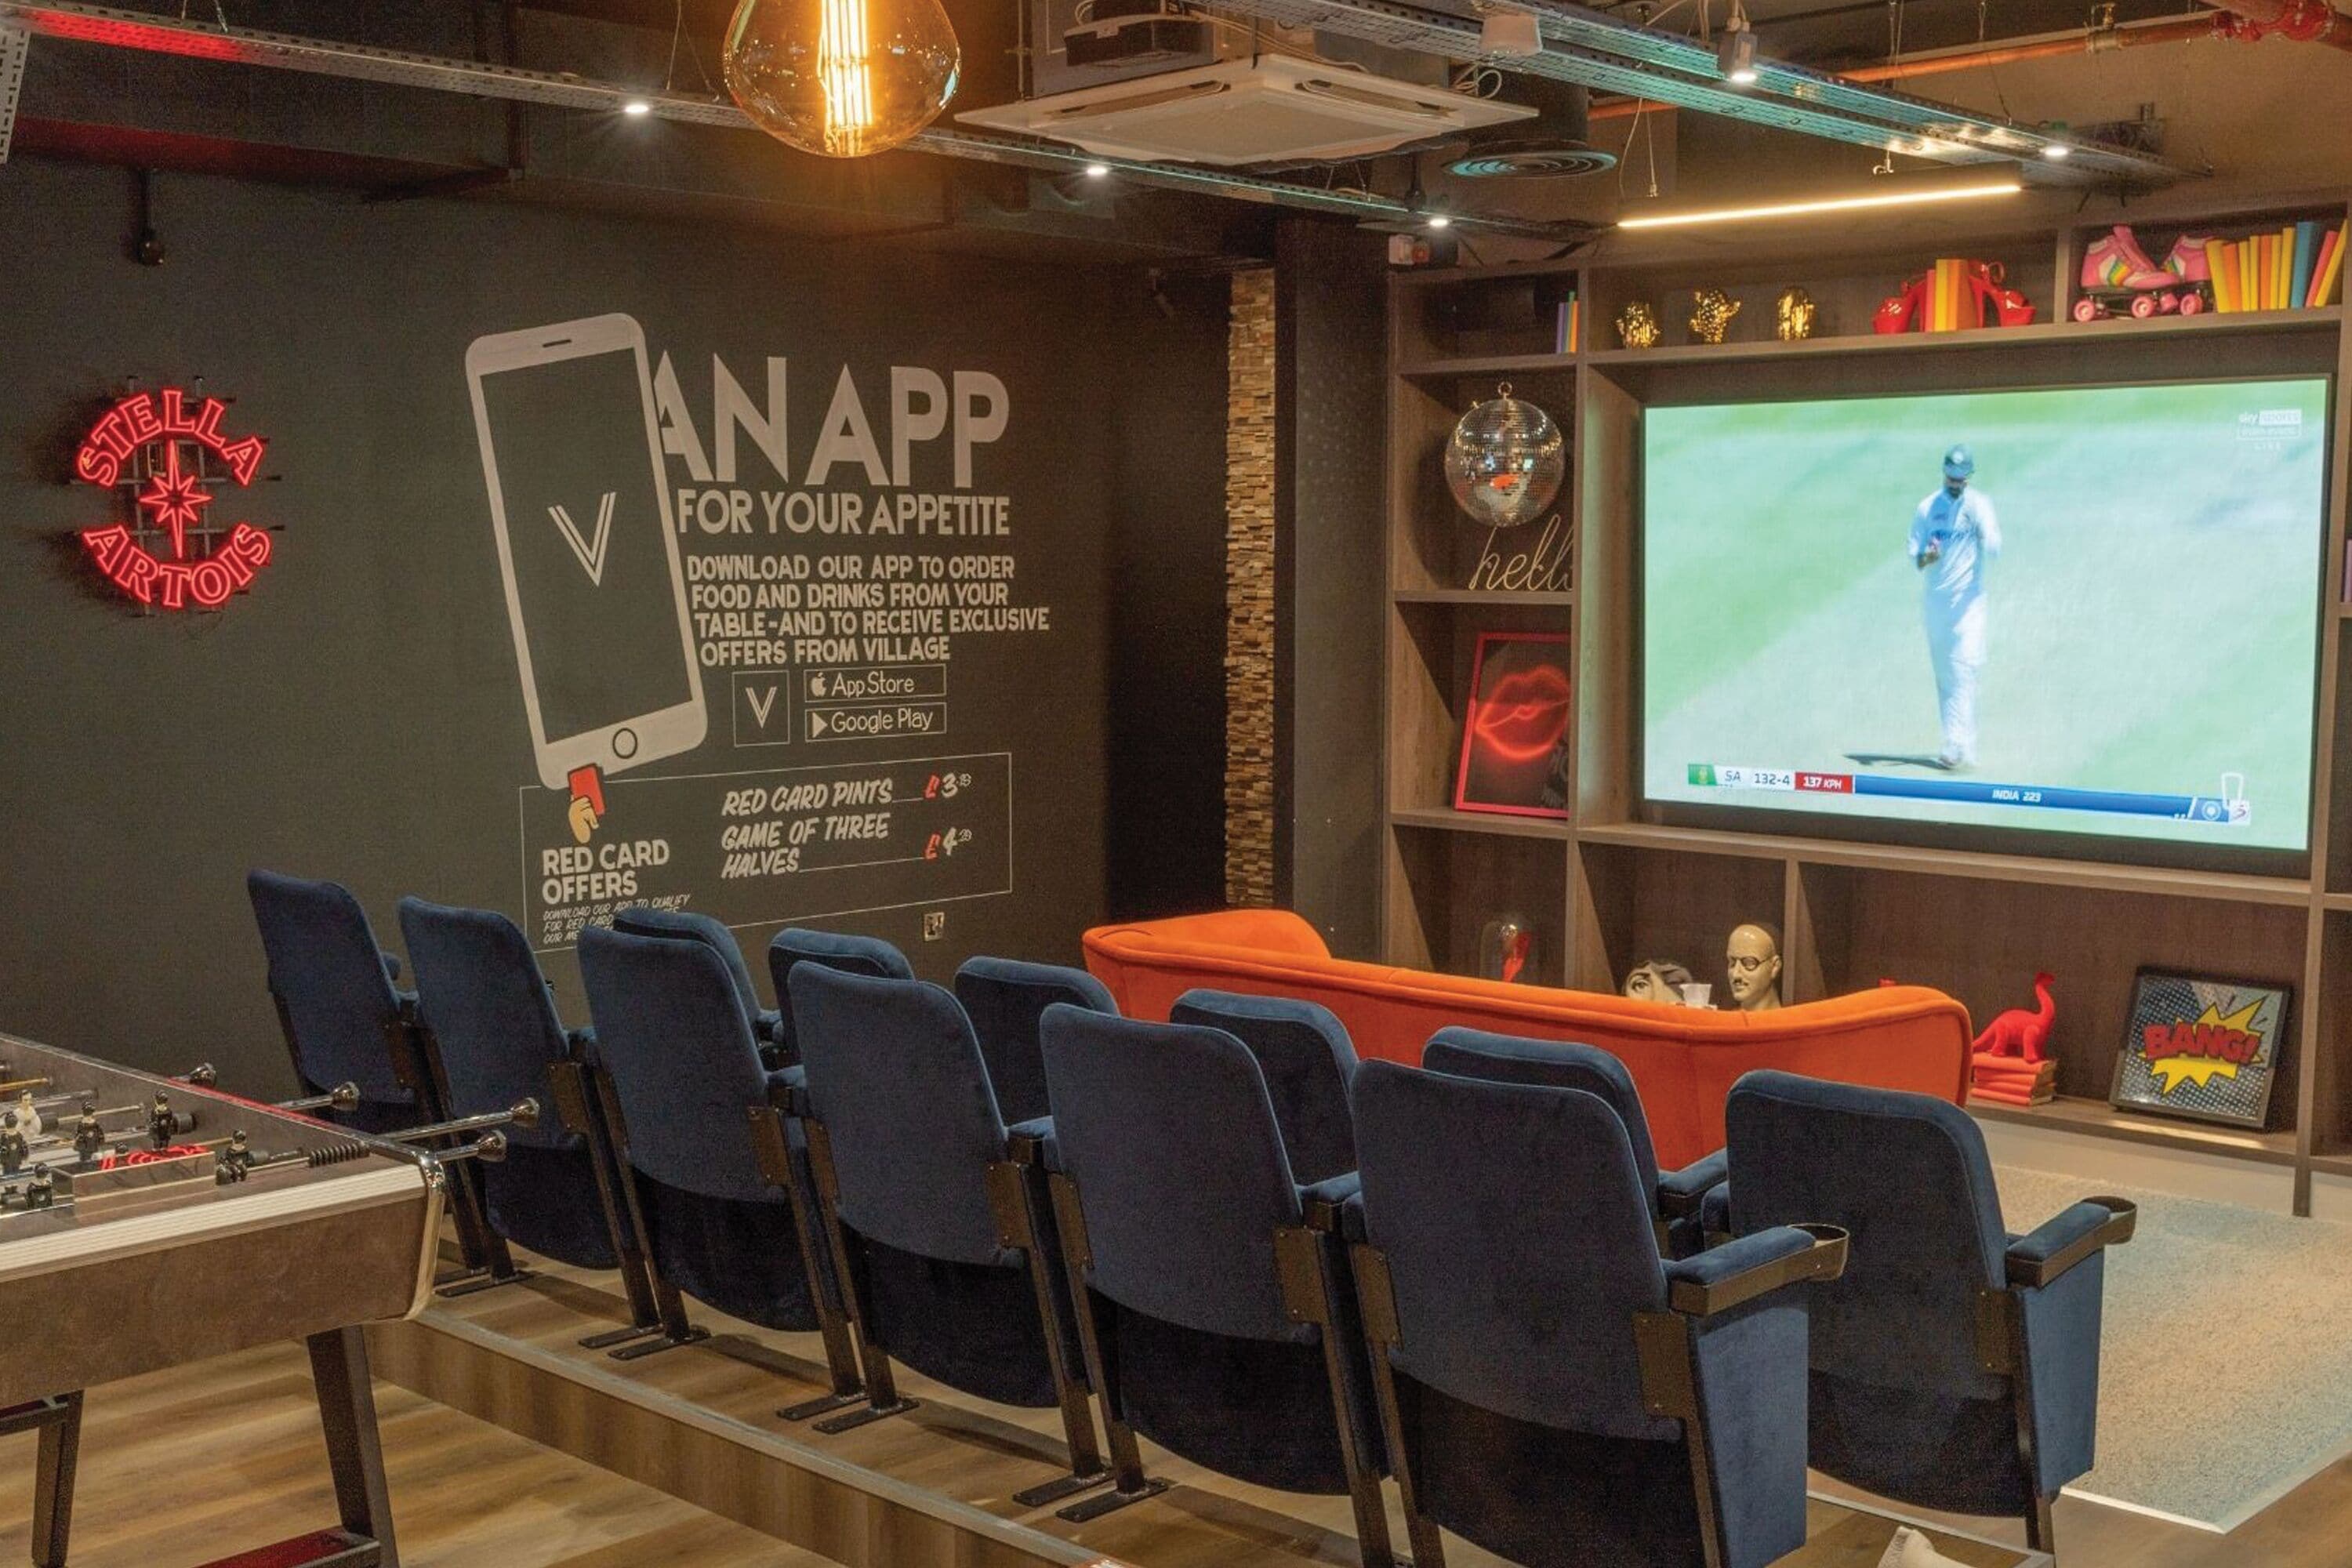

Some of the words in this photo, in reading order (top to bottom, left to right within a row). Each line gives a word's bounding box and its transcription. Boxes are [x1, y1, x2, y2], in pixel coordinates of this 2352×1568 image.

[653, 350, 789, 483] AN
[804, 363, 1010, 488] APP
[78, 389, 264, 487] STELLA
[677, 488, 753, 534] FOR
[760, 492, 863, 535] YOUR
[868, 494, 1010, 535] APPETITE
[83, 523, 271, 608] ARTOIS
[687, 554, 811, 581] DOWNLOAD
[818, 555, 863, 579] OUR
[870, 554, 913, 579] APP
[918, 555, 945, 579] TO
[949, 555, 1015, 579] ORDER
[1468, 514, 1573, 591] hell
[691, 583, 752, 609] FOOD
[755, 583, 801, 609] AND
[807, 583, 885, 609] DRINKS
[890, 583, 951, 608] FROM
[953, 583, 1009, 606] YOUR
[829, 610, 858, 636] TO
[862, 608, 944, 635] RECEIVE
[949, 606, 1051, 633] EXCLUSIVE
[700, 638, 788, 666] OFFERS
[794, 637, 859, 665] FROM
[863, 636, 951, 662] VILLAGE
[831, 673, 865, 698] App
[868, 670, 915, 695] Store
[831, 710, 894, 734] Google
[898, 708, 933, 731] Play
[1725, 770, 1741, 782] SA
[1755, 773, 1790, 786] 132-4
[1804, 775, 1823, 788] 137
[1824, 778, 1842, 789] KPH
[1992, 789, 2020, 800] INDIA
[720, 788, 768, 817] RED
[771, 783, 829, 813] CARD
[831, 777, 894, 808] PINTS
[720, 821, 783, 851] GAME
[789, 817, 820, 846] OF
[824, 812, 891, 842] THREE
[543, 846, 593, 877] RED
[599, 839, 670, 871] CARD
[720, 847, 800, 880] HALVES
[542, 869, 639, 906] OFFERS
[593, 902, 612, 915] OUR
[636, 898, 649, 908] TO
[652, 894, 690, 908] QUALIFY
[543, 920, 564, 934] FOR
[566, 917, 586, 930] RED
[543, 931, 564, 945] OUR
[2143, 1022, 2260, 1065] BANG!
